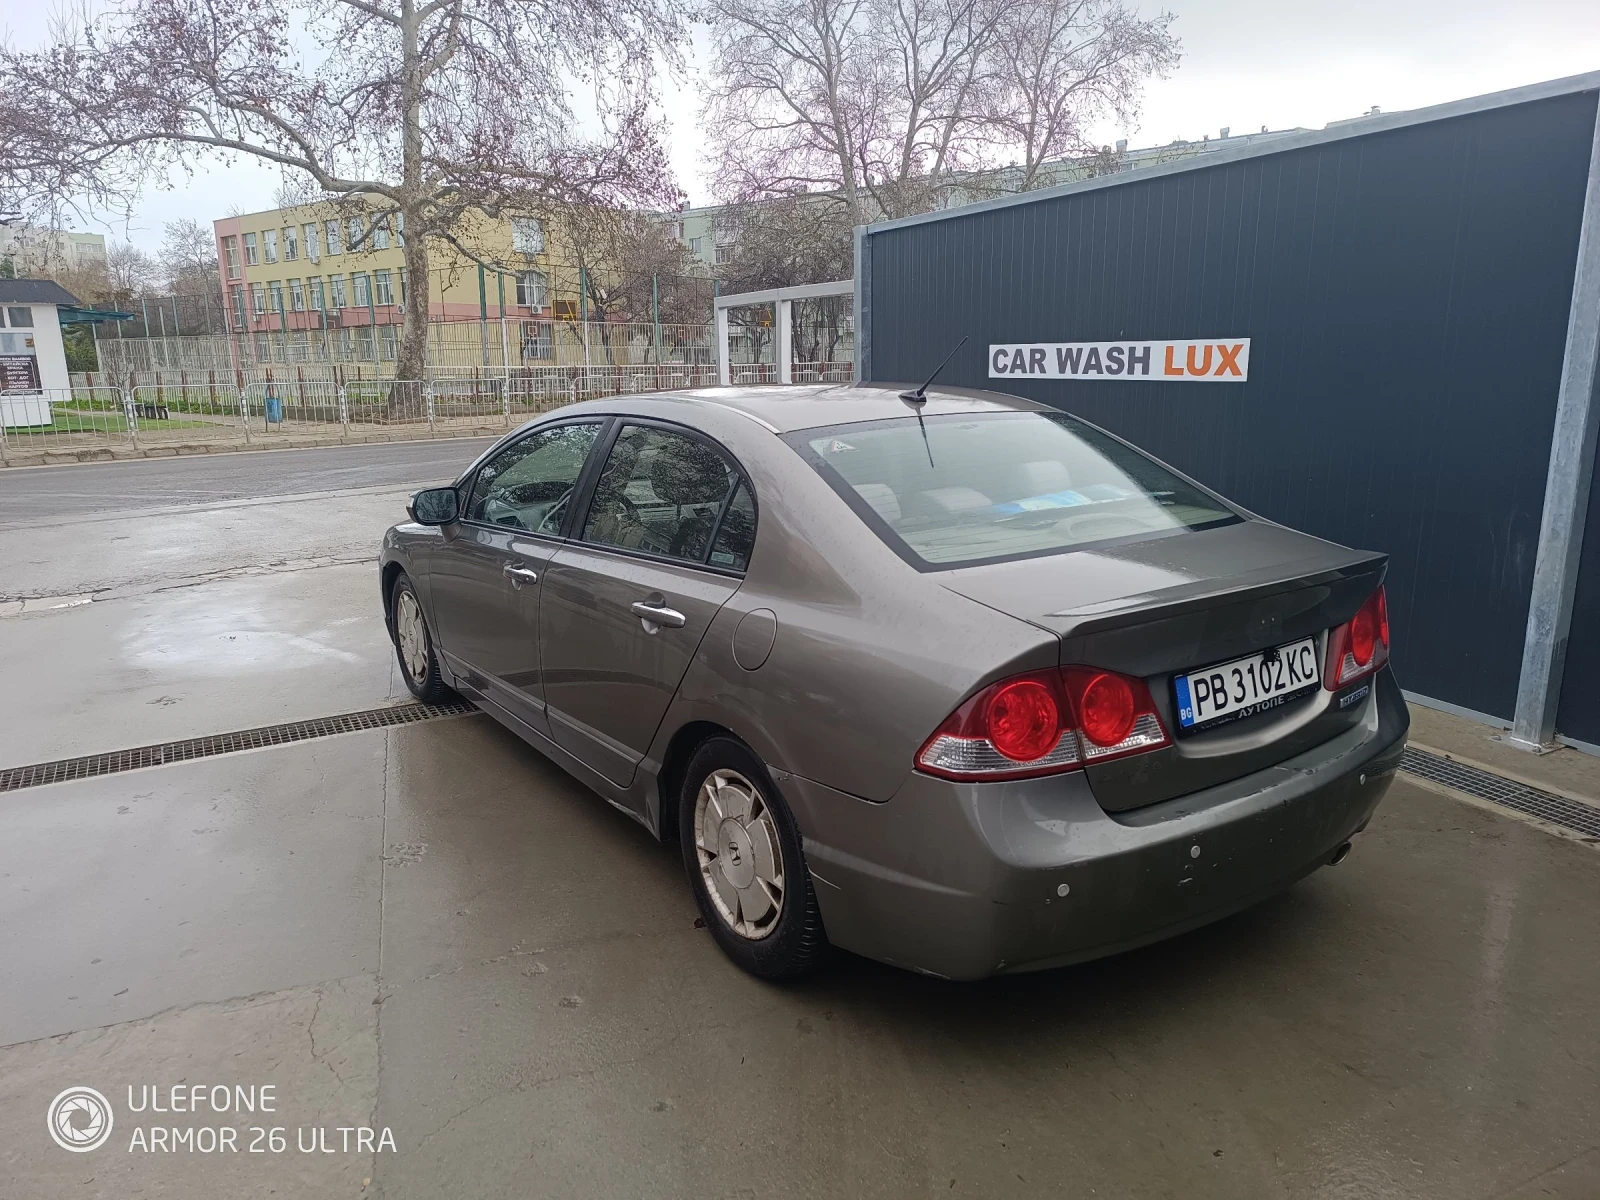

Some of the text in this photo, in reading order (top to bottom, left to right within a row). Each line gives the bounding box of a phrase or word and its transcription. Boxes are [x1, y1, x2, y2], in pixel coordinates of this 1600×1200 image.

[992, 344, 1244, 376] CAR WASH LUX
[1180, 707, 1192, 721] BG
